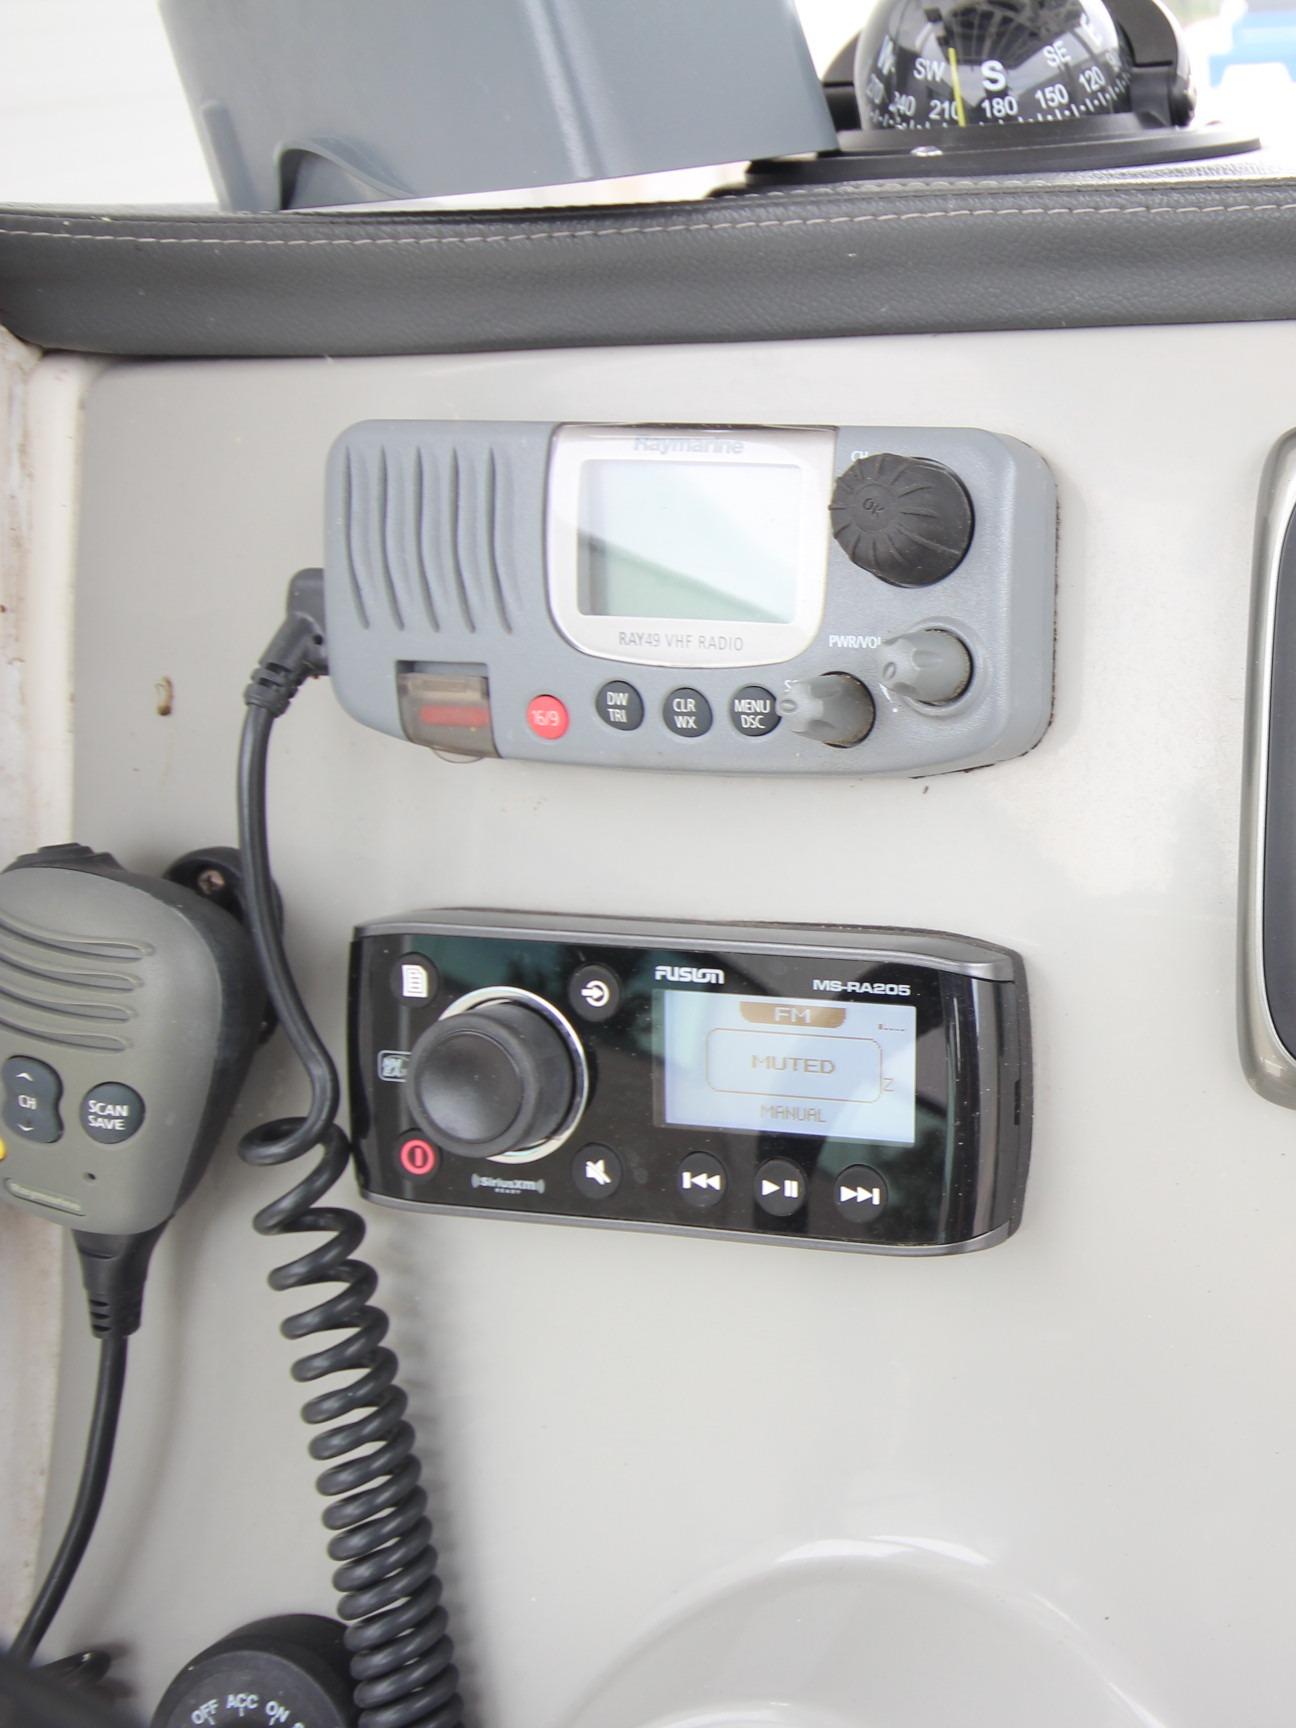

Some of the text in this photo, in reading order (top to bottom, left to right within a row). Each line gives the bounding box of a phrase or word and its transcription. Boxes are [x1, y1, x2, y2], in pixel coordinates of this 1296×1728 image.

[913, 57, 945, 82] SW
[981, 61, 1007, 91] S
[1044, 40, 1071, 67] SE
[981, 95, 1018, 119] 180
[1035, 83, 1069, 109] 150
[1079, 66, 1106, 93] 120
[863, 498, 885, 518] OK
[618, 631, 744, 652] RAY49 VHF RADIO
[829, 634, 882, 649] PWR/VO
[606, 692, 629, 706] DW
[673, 698, 696, 713] CLR
[734, 699, 770, 713] MENU
[531, 709, 561, 727] 16/9
[608, 709, 627, 723] TRI
[675, 716, 697, 729] WX
[741, 715, 765, 729] DSC
[812, 979, 911, 996] MS-RA205
[773, 1006, 812, 1024] FM
[751, 1054, 836, 1075] MUTED
[18, 1094, 37, 1110] CH
[88, 1100, 129, 1117] SCAN
[760, 1103, 828, 1123] MANUAL
[88, 1115, 126, 1131] SAVE
[191, 1694, 291, 1725] OFF ACC ON
